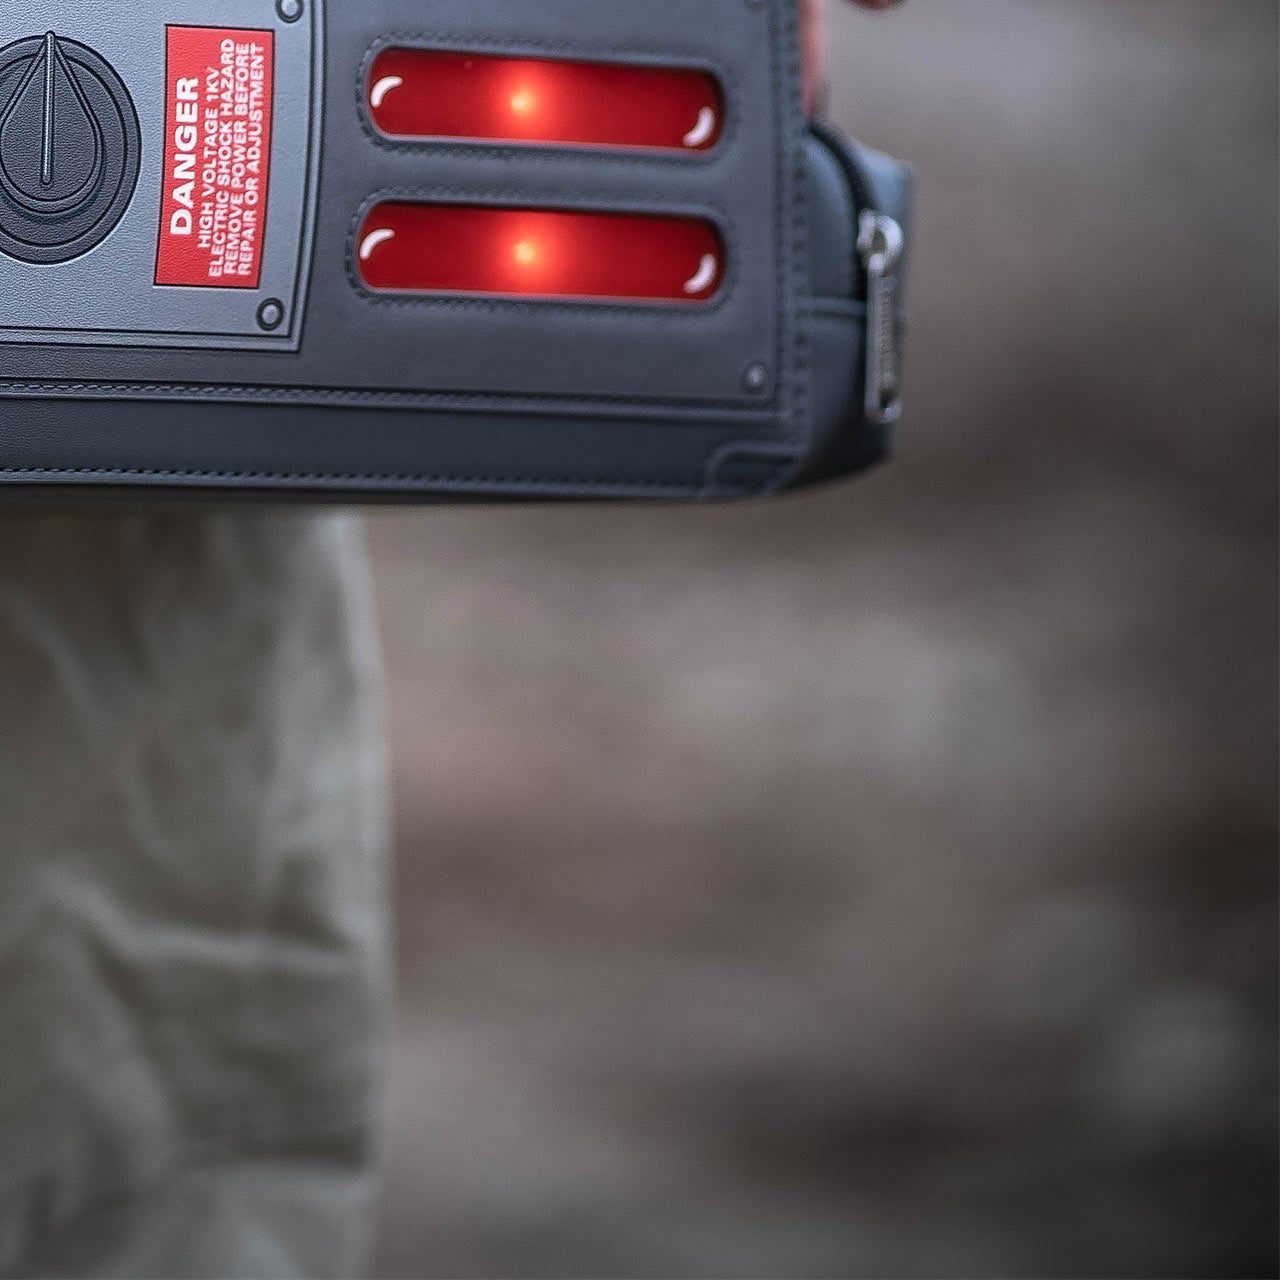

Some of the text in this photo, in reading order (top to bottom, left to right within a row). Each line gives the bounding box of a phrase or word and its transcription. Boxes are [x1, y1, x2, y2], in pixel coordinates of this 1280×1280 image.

[170, 77, 199, 235] DANGER
[197, 66, 220, 248] HIGH VOLTAGE 1KV
[208, 39, 235, 277] ELECTRIC SHOCK HAZARD
[224, 43, 249, 275] REMOVE POWER BEFORE
[238, 42, 264, 275] REPAIR OR ADJUSTMENT
